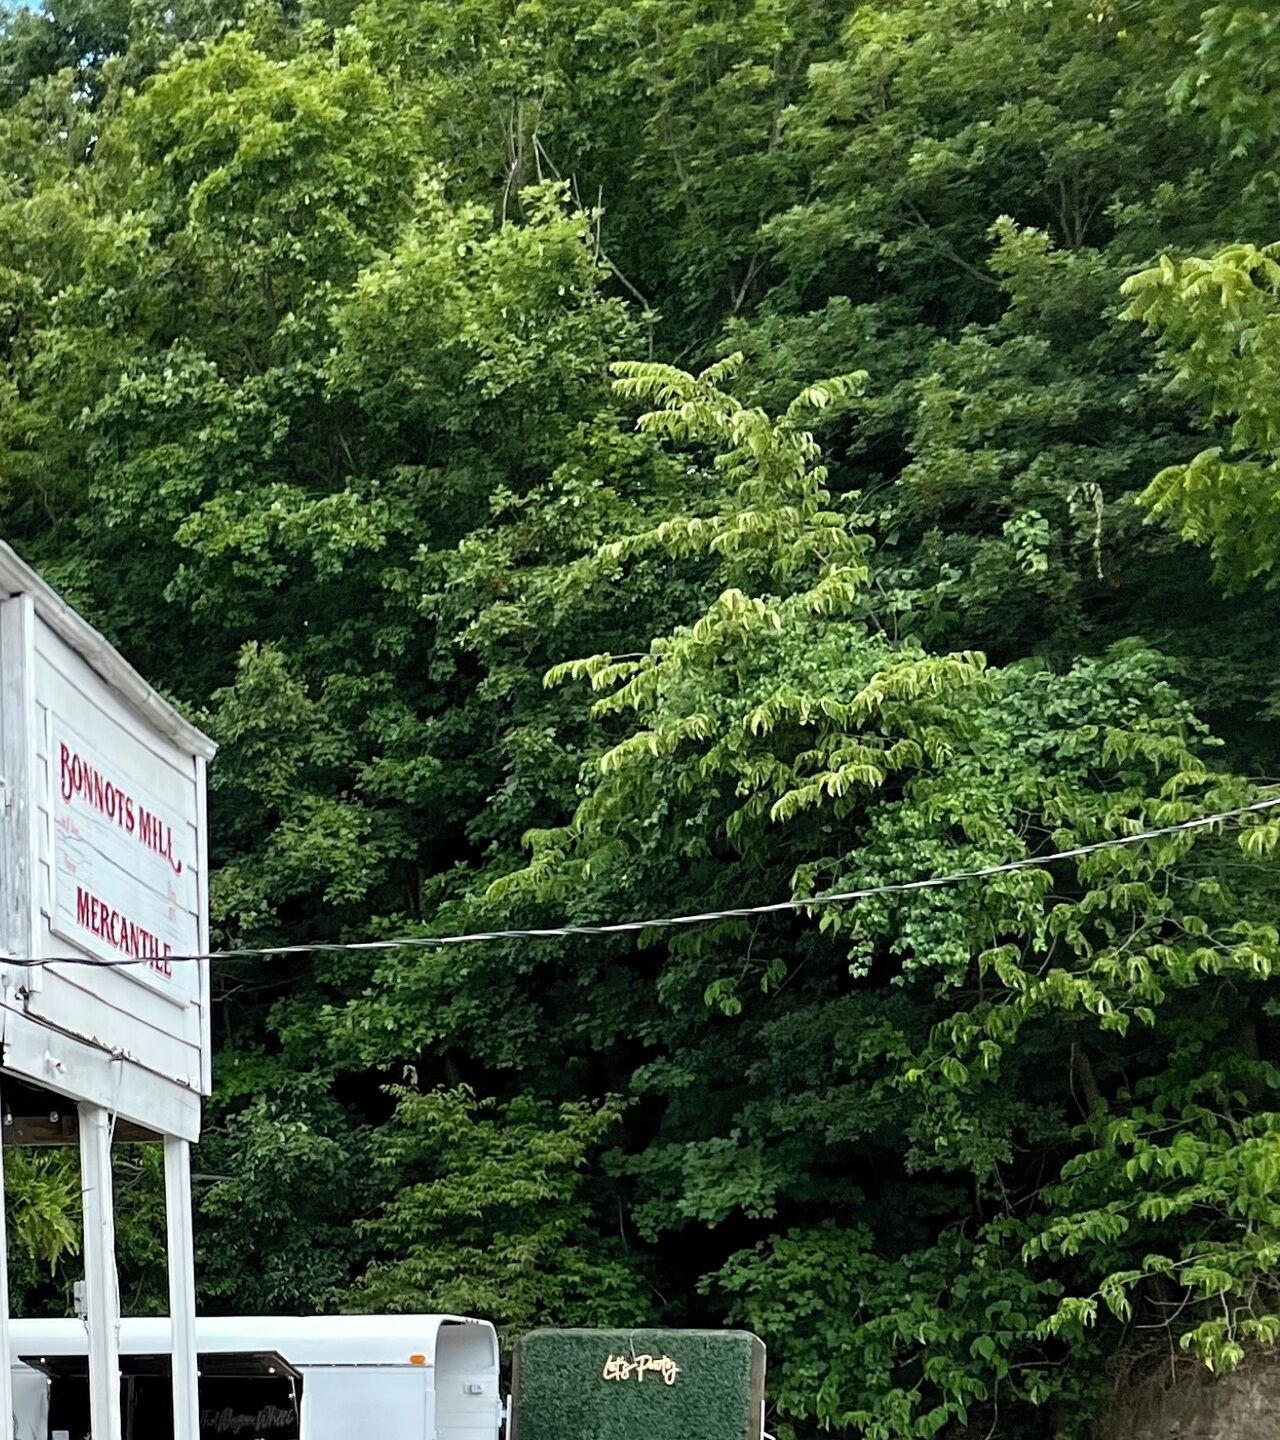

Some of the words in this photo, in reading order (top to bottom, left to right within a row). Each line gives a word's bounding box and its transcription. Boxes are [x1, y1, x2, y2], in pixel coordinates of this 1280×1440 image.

[60, 742, 135, 835] BONNOTS
[138, 806, 182, 875] MILL
[76, 885, 173, 977] MERCANTILE
[636, 1354, 680, 1385] Party
